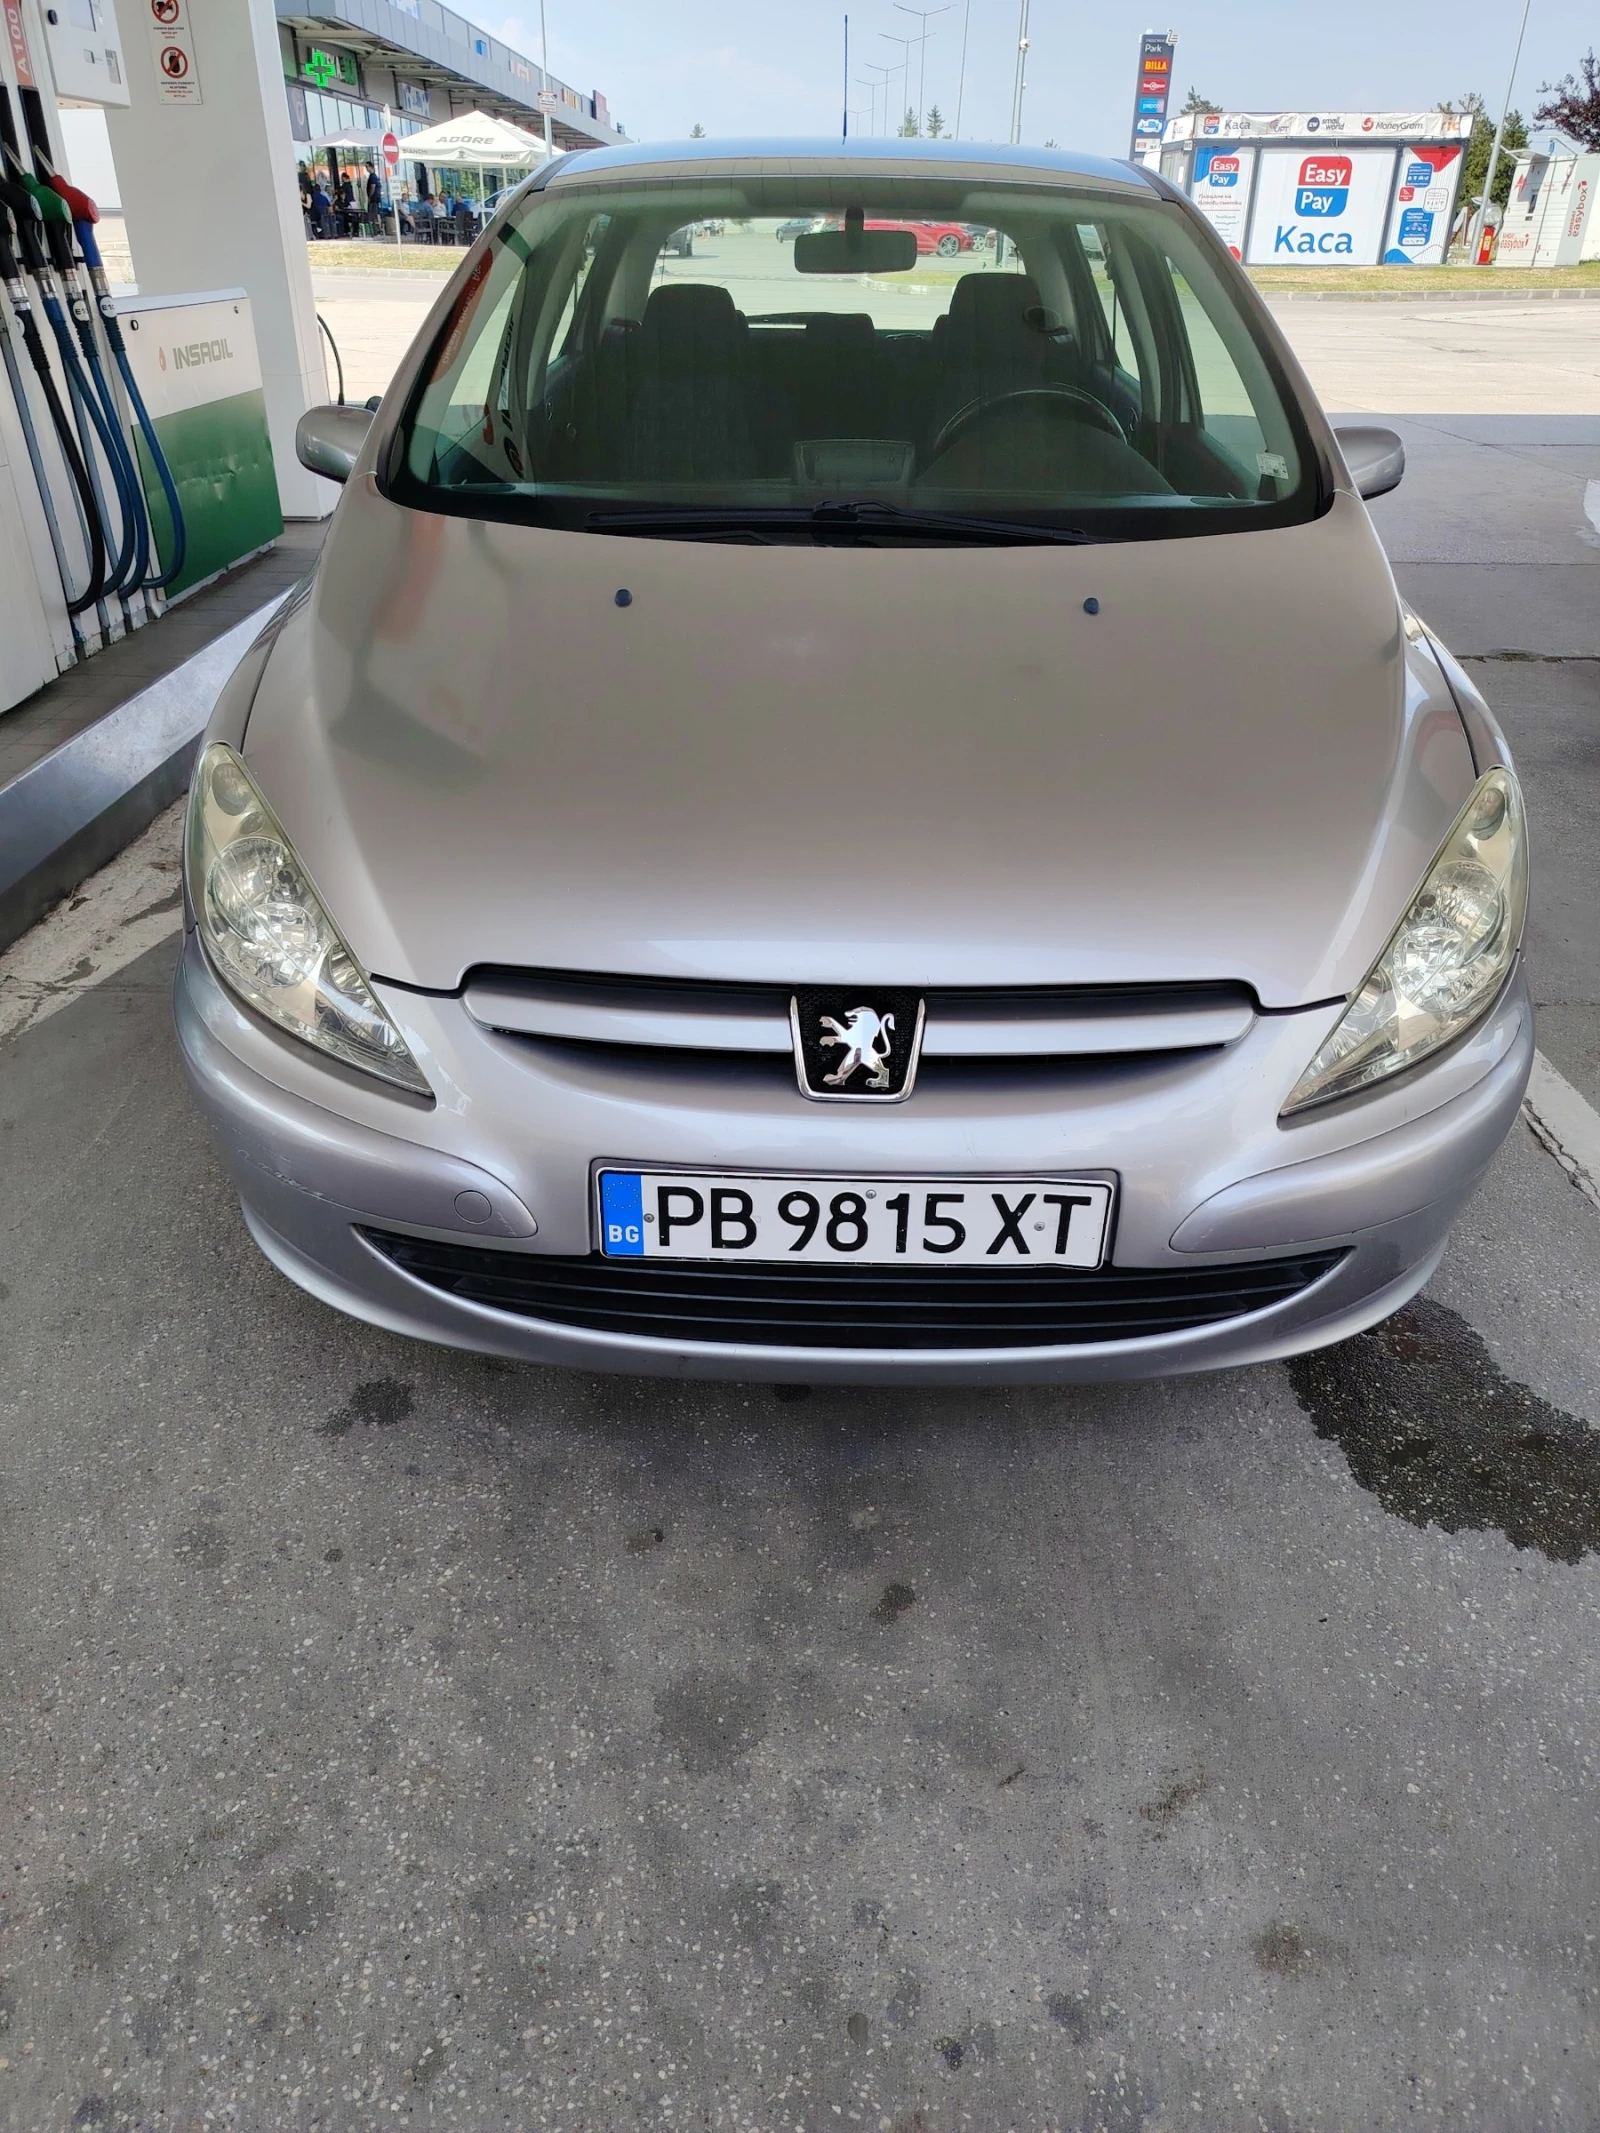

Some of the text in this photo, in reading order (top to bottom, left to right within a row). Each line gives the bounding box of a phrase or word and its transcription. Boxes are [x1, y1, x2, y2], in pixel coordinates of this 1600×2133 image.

[7, 8, 29, 75] A100
[1144, 43, 1163, 53] Park
[1144, 60, 1167, 71] BILLA
[1321, 116, 1340, 124] small
[435, 135, 495, 145] ADORE
[1212, 161, 1237, 172] Easy
[1304, 163, 1347, 186] Easy
[1211, 174, 1230, 186] Pay
[1300, 191, 1334, 214] Pay
[1572, 187, 1588, 238] easybox
[1273, 225, 1354, 254] Каса
[75, 308, 88, 316] E1
[172, 338, 234, 370] INSAOIL
[657, 1186, 1092, 1256] PB 9815 XT
[608, 1224, 639, 1244] BG
